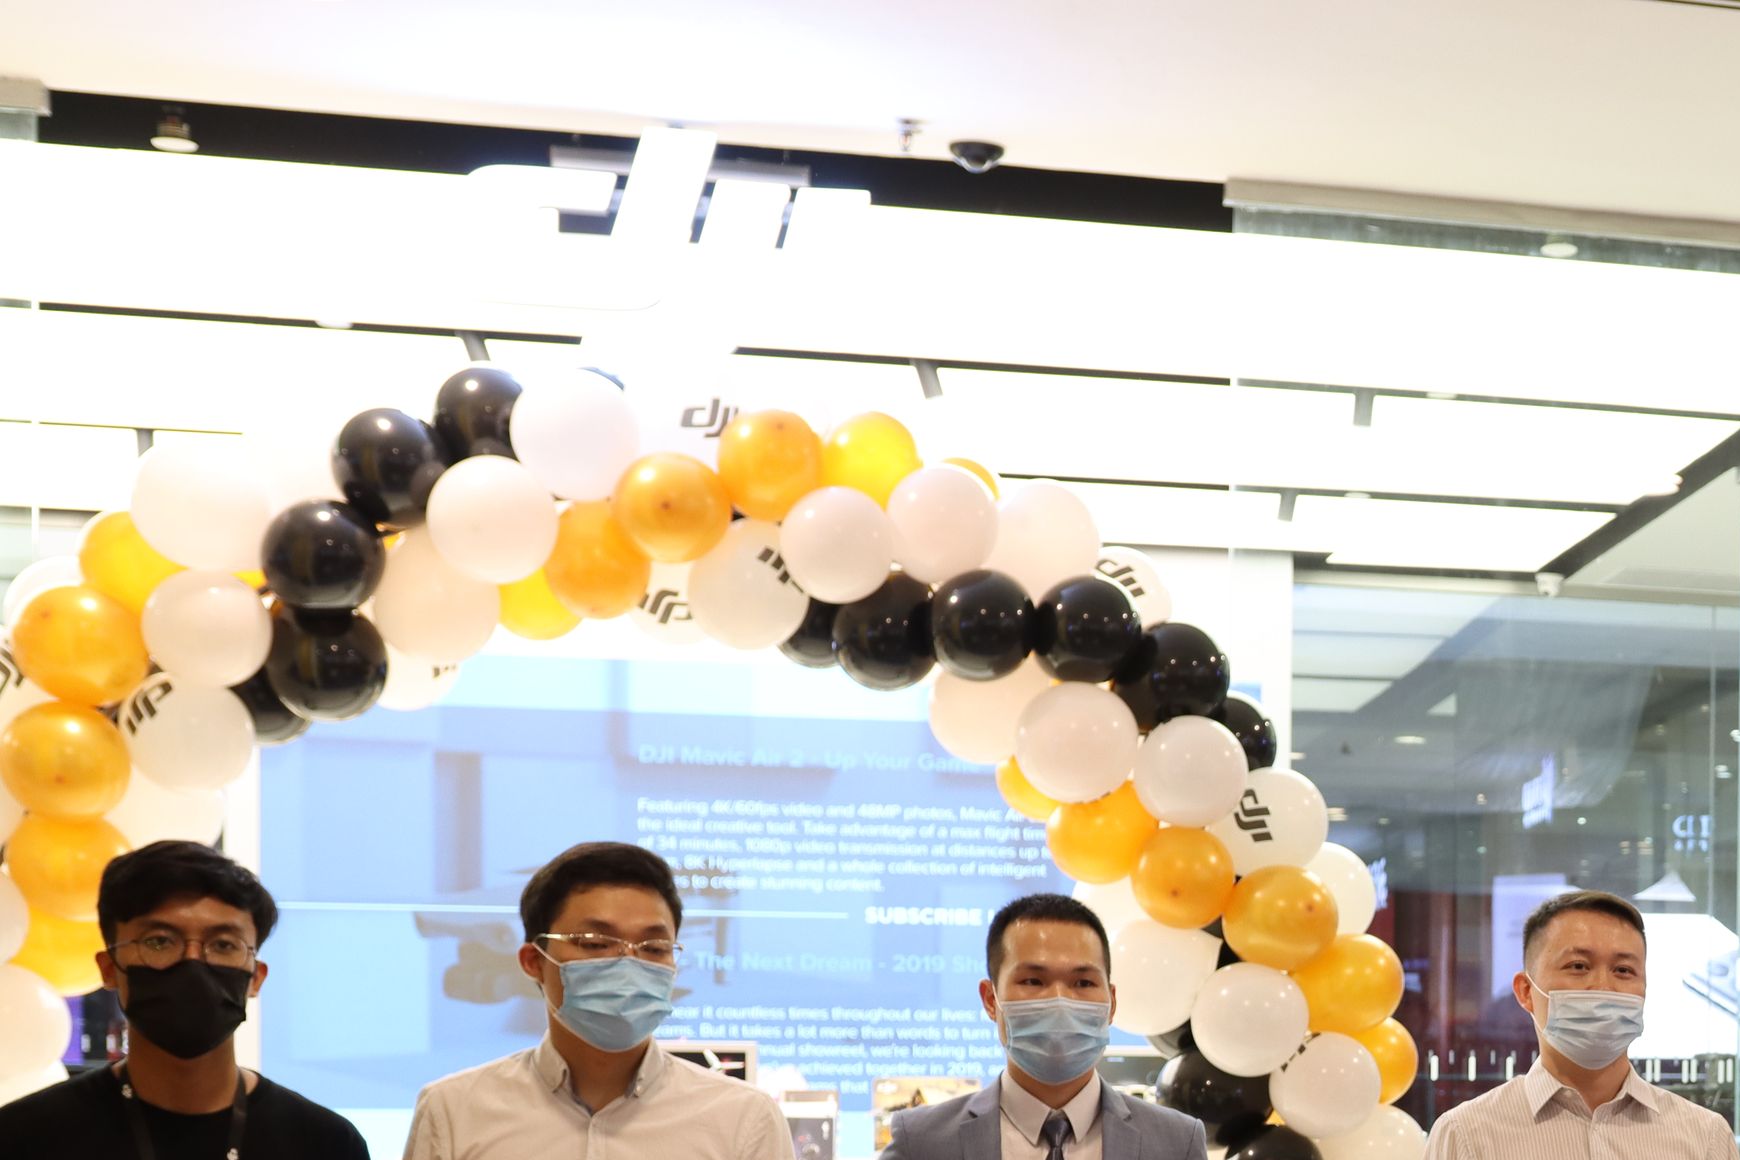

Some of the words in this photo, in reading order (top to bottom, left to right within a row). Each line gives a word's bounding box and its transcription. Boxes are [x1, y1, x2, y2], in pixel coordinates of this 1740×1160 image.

[638, 745, 675, 764] DJI
[680, 745, 747, 766] Mavic
[751, 747, 783, 767] Air
[824, 752, 857, 772] Up
[862, 753, 911, 772] Your
[637, 797, 709, 817] Featuring
[781, 802, 824, 818] video
[825, 803, 856, 818] and
[960, 806, 1002, 822] Mavic
[637, 817, 662, 833] the
[665, 817, 704, 834] ideal
[705, 818, 765, 835] creative
[803, 820, 838, 836] Take
[839, 822, 917, 840] advantage
[918, 823, 936, 838] of
[1022, 827, 1048, 841] tim
[794, 840, 836, 854] video
[838, 841, 929, 858] transmission
[931, 843, 947, 858] at
[948, 844, 1017, 860] distances
[1018, 847, 1040, 863] up
[795, 857, 826, 872] and
[840, 858, 886, 874] whole
[888, 860, 958, 876] collection
[960, 862, 977, 877] of
[977, 862, 1047, 881] intelligent
[691, 874, 709, 890] to
[710, 875, 758, 891] create
[864, 905, 983, 927] SUBSCRIBE
[696, 951, 735, 970] The
[741, 952, 794, 972] Next
[800, 953, 873, 973] Dream
[892, 954, 946, 974] 2019
[715, 1005, 787, 1021] countless
[788, 1006, 829, 1021] times
[831, 1007, 911, 1023] throughout
[913, 1009, 939, 1022] our
[699, 1022, 726, 1038] But
[741, 1023, 782, 1038] takes
[797, 1024, 818, 1039] lot
[819, 1027, 859, 1040] more
[860, 1025, 895, 1041] than
[896, 1026, 942, 1041] words
[943, 1026, 960, 1041] to
[912, 1044, 966, 1061] looking
[797, 1059, 864, 1077] achieved
[866, 1061, 928, 1080] together
[840, 1080, 869, 1095] that
